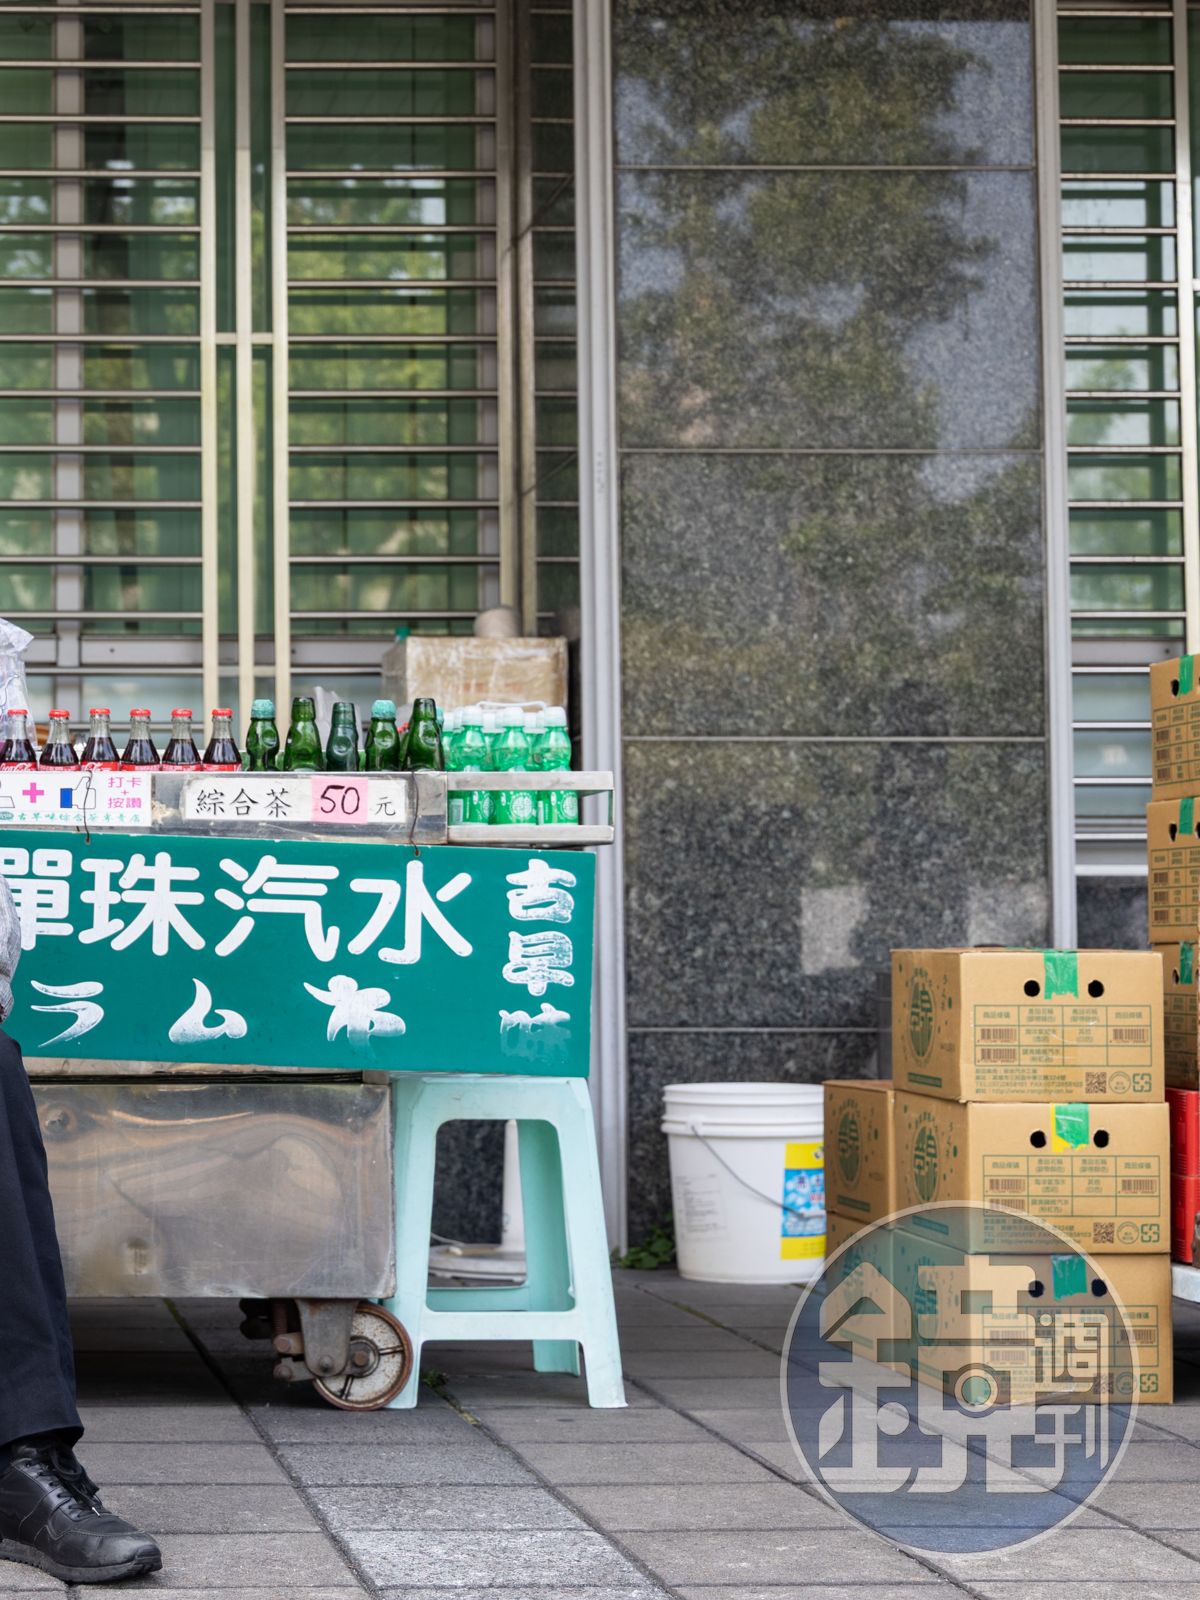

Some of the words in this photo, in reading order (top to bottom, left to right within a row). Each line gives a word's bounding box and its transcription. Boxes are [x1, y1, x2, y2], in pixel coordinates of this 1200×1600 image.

[108, 777, 142, 789] 打卡
[108, 797, 142, 810] 按讚
[195, 787, 293, 819] 綜合茶
[319, 784, 361, 816] 50
[374, 795, 397, 817] 元
